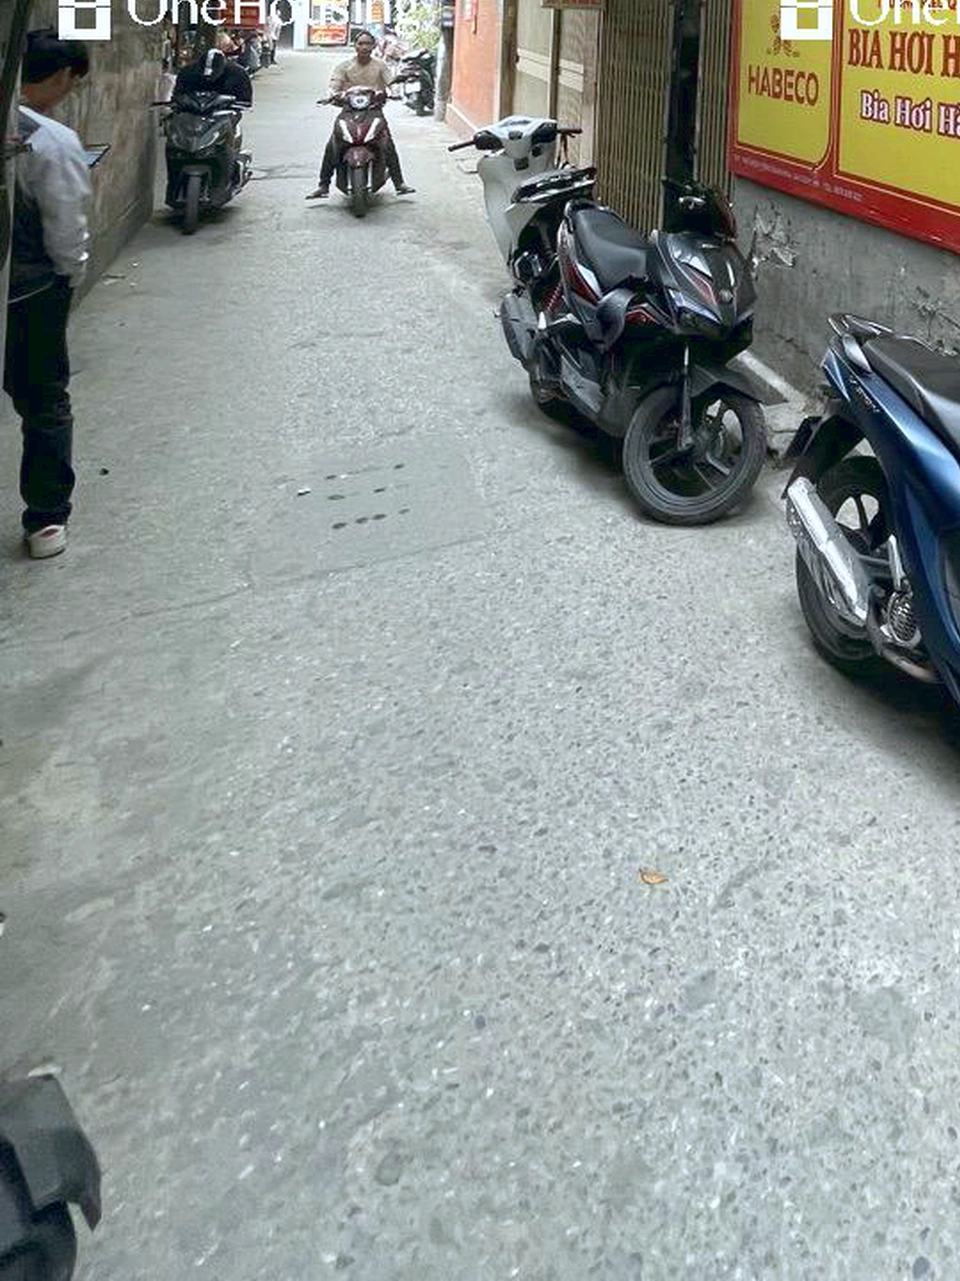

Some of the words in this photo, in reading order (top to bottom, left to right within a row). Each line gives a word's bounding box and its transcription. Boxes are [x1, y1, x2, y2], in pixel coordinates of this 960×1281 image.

[847, 28, 884, 70] BIA
[889, 30, 936, 76] HƠI
[748, 65, 819, 106] HABECO
[860, 90, 891, 126] Bia
[894, 95, 931, 135] Hơi
